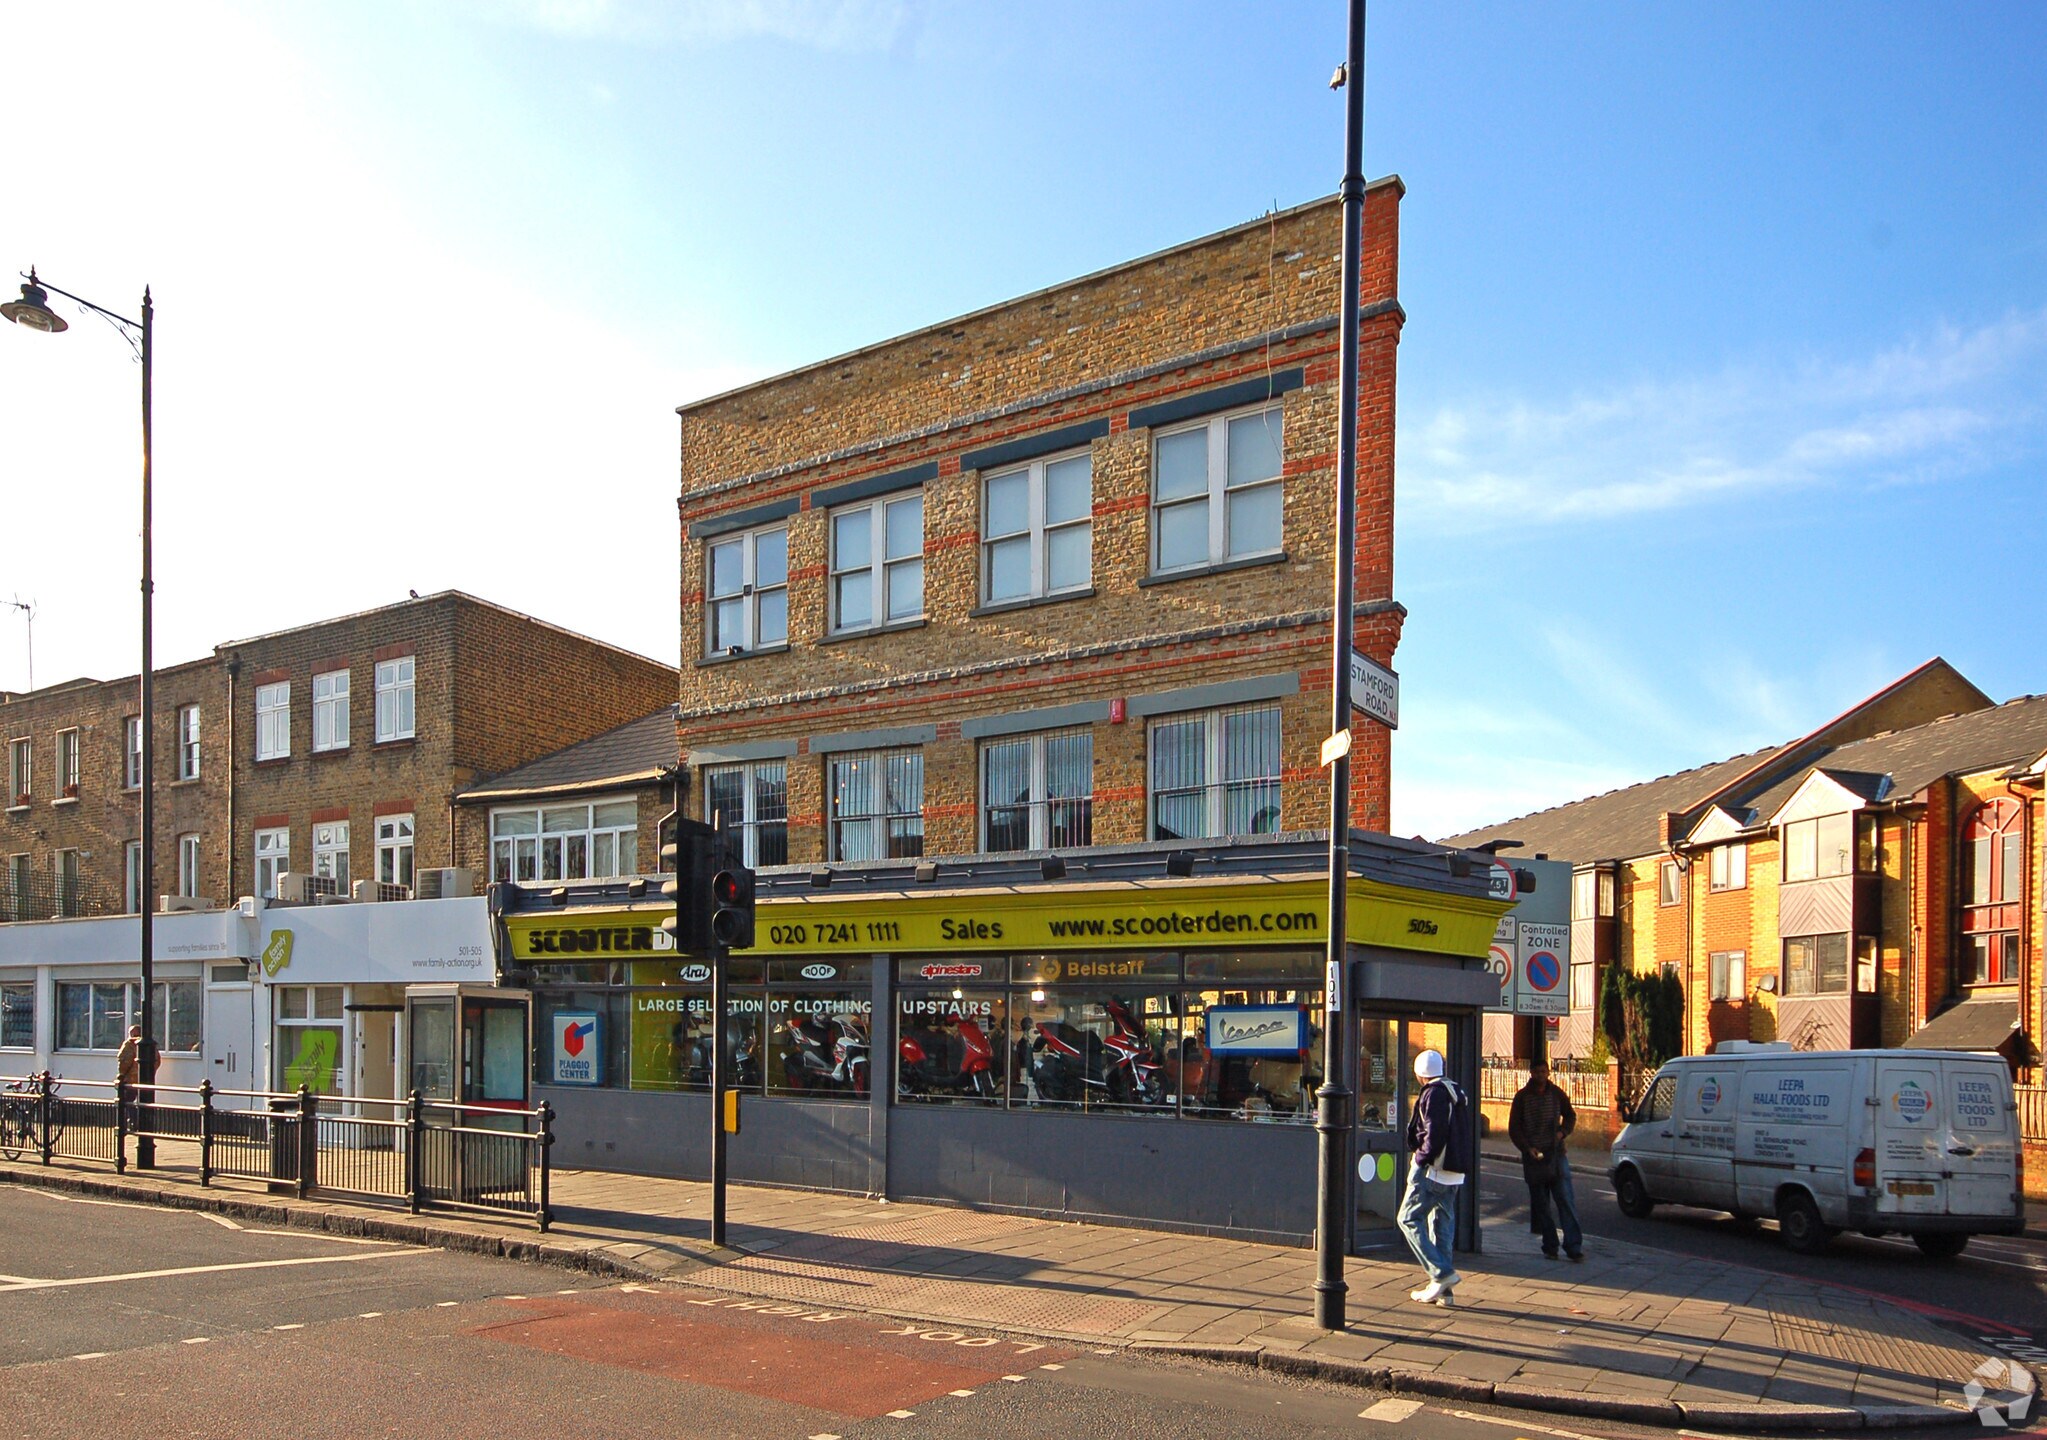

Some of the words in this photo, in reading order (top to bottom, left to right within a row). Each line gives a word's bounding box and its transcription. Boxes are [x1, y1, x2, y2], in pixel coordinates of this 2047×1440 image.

[1351, 664, 1394, 700] STAMFORD
[1366, 692, 1388, 716] ROAD
[940, 917, 1004, 941] Sales
[1047, 910, 1319, 938] www.scooterden.com
[1521, 924, 1568, 936] Controlled
[528, 926, 677, 953] SCOOTERD
[770, 925, 806, 945] 020
[814, 922, 859, 943] 7241
[867, 921, 901, 942] 1111
[269, 934, 286, 959] family
[1527, 936, 1560, 949] ZONE
[458, 946, 483, 957] 501-505
[267, 948, 285, 973] action
[411, 957, 483, 970] www.family-action.org.uk
[1067, 960, 1145, 977] Belstaff
[804, 966, 833, 977] ROOF
[920, 963, 982, 980] alpinestars
[1328, 966, 1337, 1007] 104
[638, 999, 684, 1012] LARGE
[687, 999, 763, 1013] SELTION
[769, 1000, 789, 1013] OF
[794, 1000, 872, 1014] CLOTHING
[902, 1000, 992, 1015] UPSTAIRS
[1218, 1017, 1289, 1045] Vespa
[559, 1060, 590, 1070] PIAGGIO
[559, 1069, 590, 1080] CENTER
[1778, 1079, 1804, 1091] LEEPA
[1958, 1081, 1992, 1093] LEEPA
[1753, 1092, 1778, 1105] HALAL
[1780, 1093, 1811, 1106] FOODS
[1812, 1095, 1830, 1107] LTD
[1958, 1093, 1993, 1104] HALAL
[1958, 1105, 1995, 1116] FOODS
[1967, 1116, 1987, 1127] LTD
[687, 1297, 847, 1323] RIGHT
[879, 1325, 1047, 1355] LOOK
